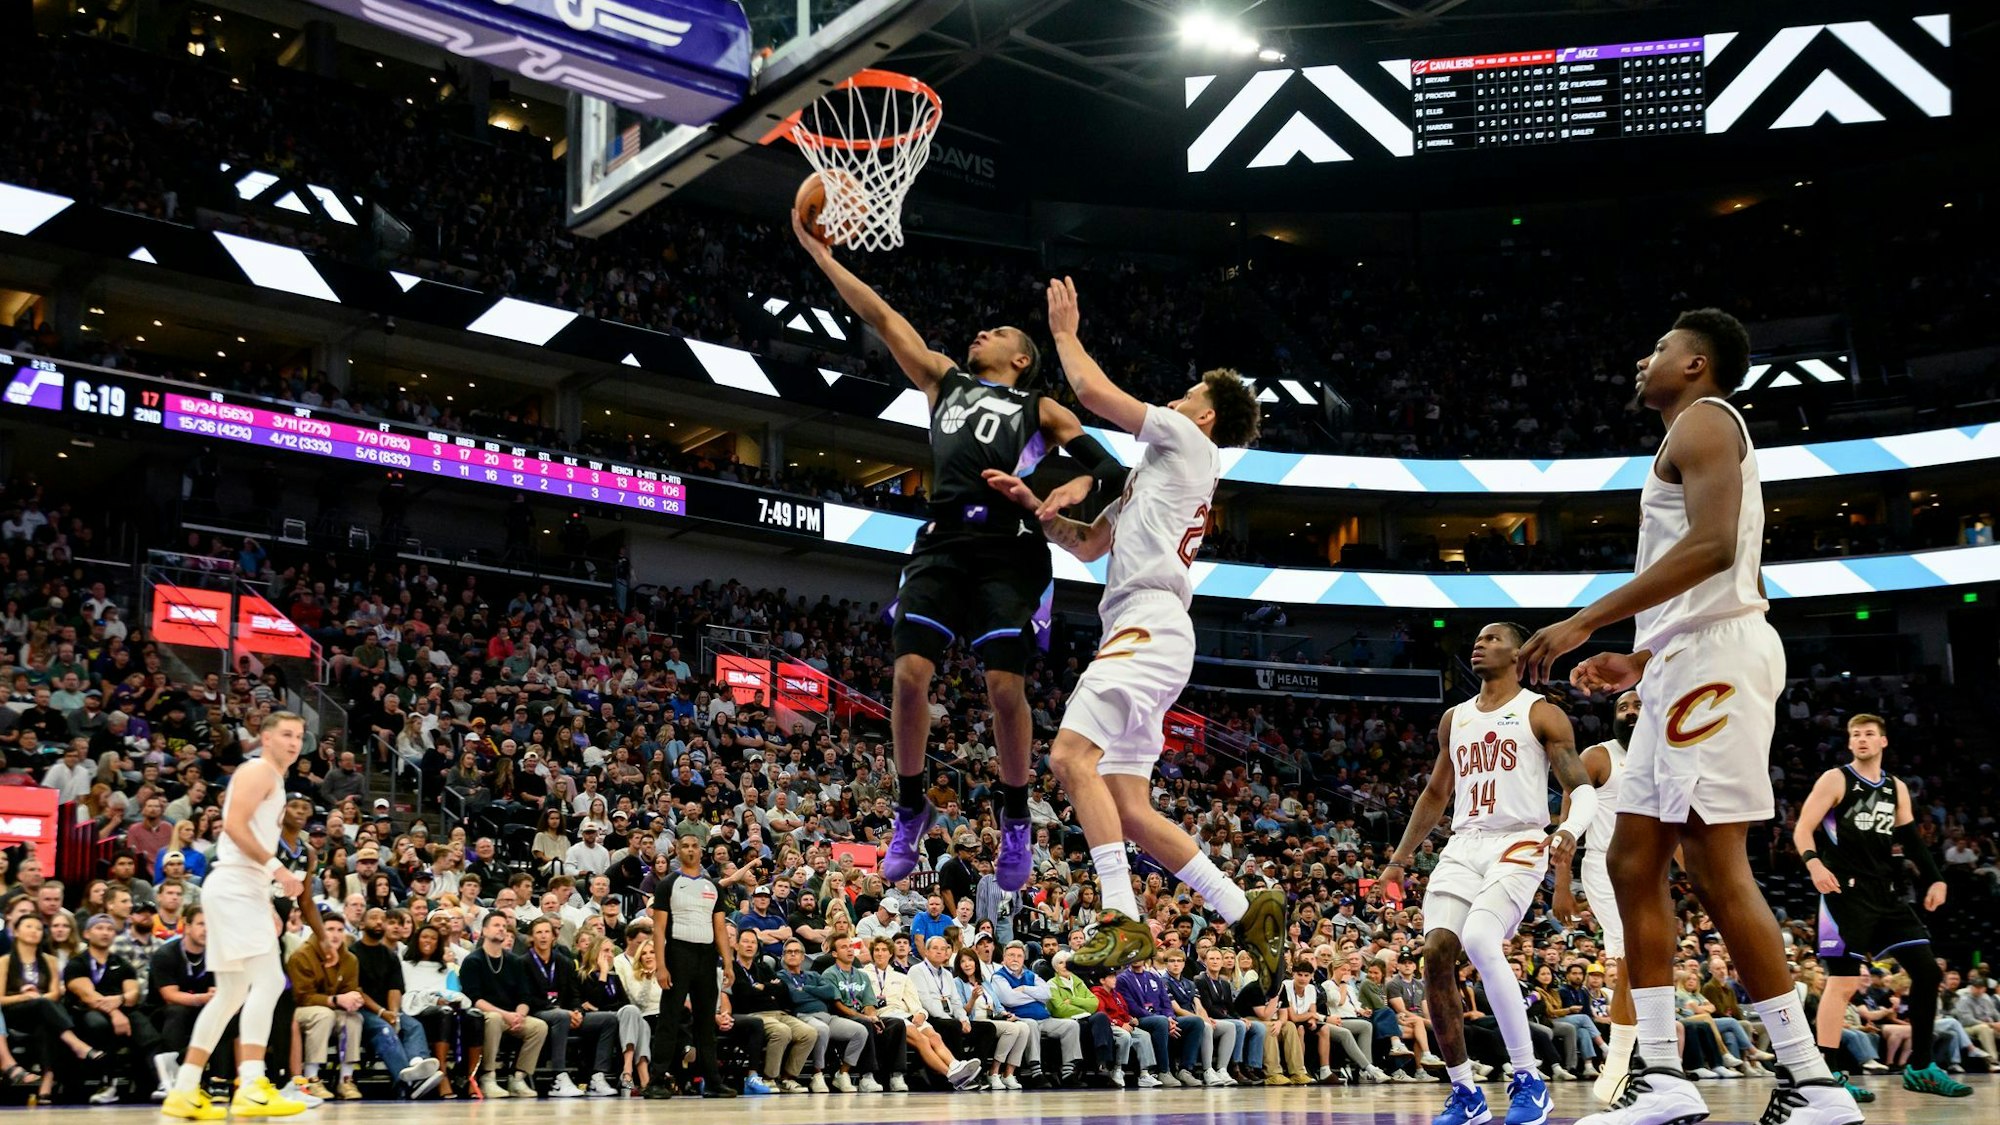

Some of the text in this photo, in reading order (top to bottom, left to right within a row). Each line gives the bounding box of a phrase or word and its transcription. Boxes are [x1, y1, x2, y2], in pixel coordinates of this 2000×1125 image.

[1574, 47, 1598, 59] JAZZ
[1430, 58, 1474, 71] CAVALIERS
[1559, 81, 1569, 91] 22
[1561, 97, 1568, 106] 5
[1426, 108, 1444, 116] ELLIS
[1417, 124, 1422, 133] 1
[1417, 140, 1423, 149] 5
[74, 380, 125, 417] 6:19
[140, 390, 160, 408] 17
[134, 407, 162, 424] 2ND
[974, 412, 1001, 445] 0
[180, 399, 679, 497] 19/34 (56%) 3/11 (27%) 7/9 (78%) 3 17 20 12 2 3 3 13 126 106
[295, 407, 311, 418] 3PT
[379, 422, 390, 432] FT
[512, 447, 526, 457] AST
[538, 452, 551, 462] STL
[564, 456, 578, 466] BLK
[589, 461, 603, 471] TOV
[611, 465, 633, 476] BENCH
[178, 416, 679, 512] 15/36 (42%) 4/12 (33%) 5/6 (83%) 5 11 16 12 2 1 3 7 106 126
[758, 498, 820, 532] 7:49 PM
[1277, 674, 1318, 686] HEALTH
[1456, 738, 1517, 777] CAVS
[1469, 779, 1496, 816] 14
[1875, 813, 1895, 835] 22
